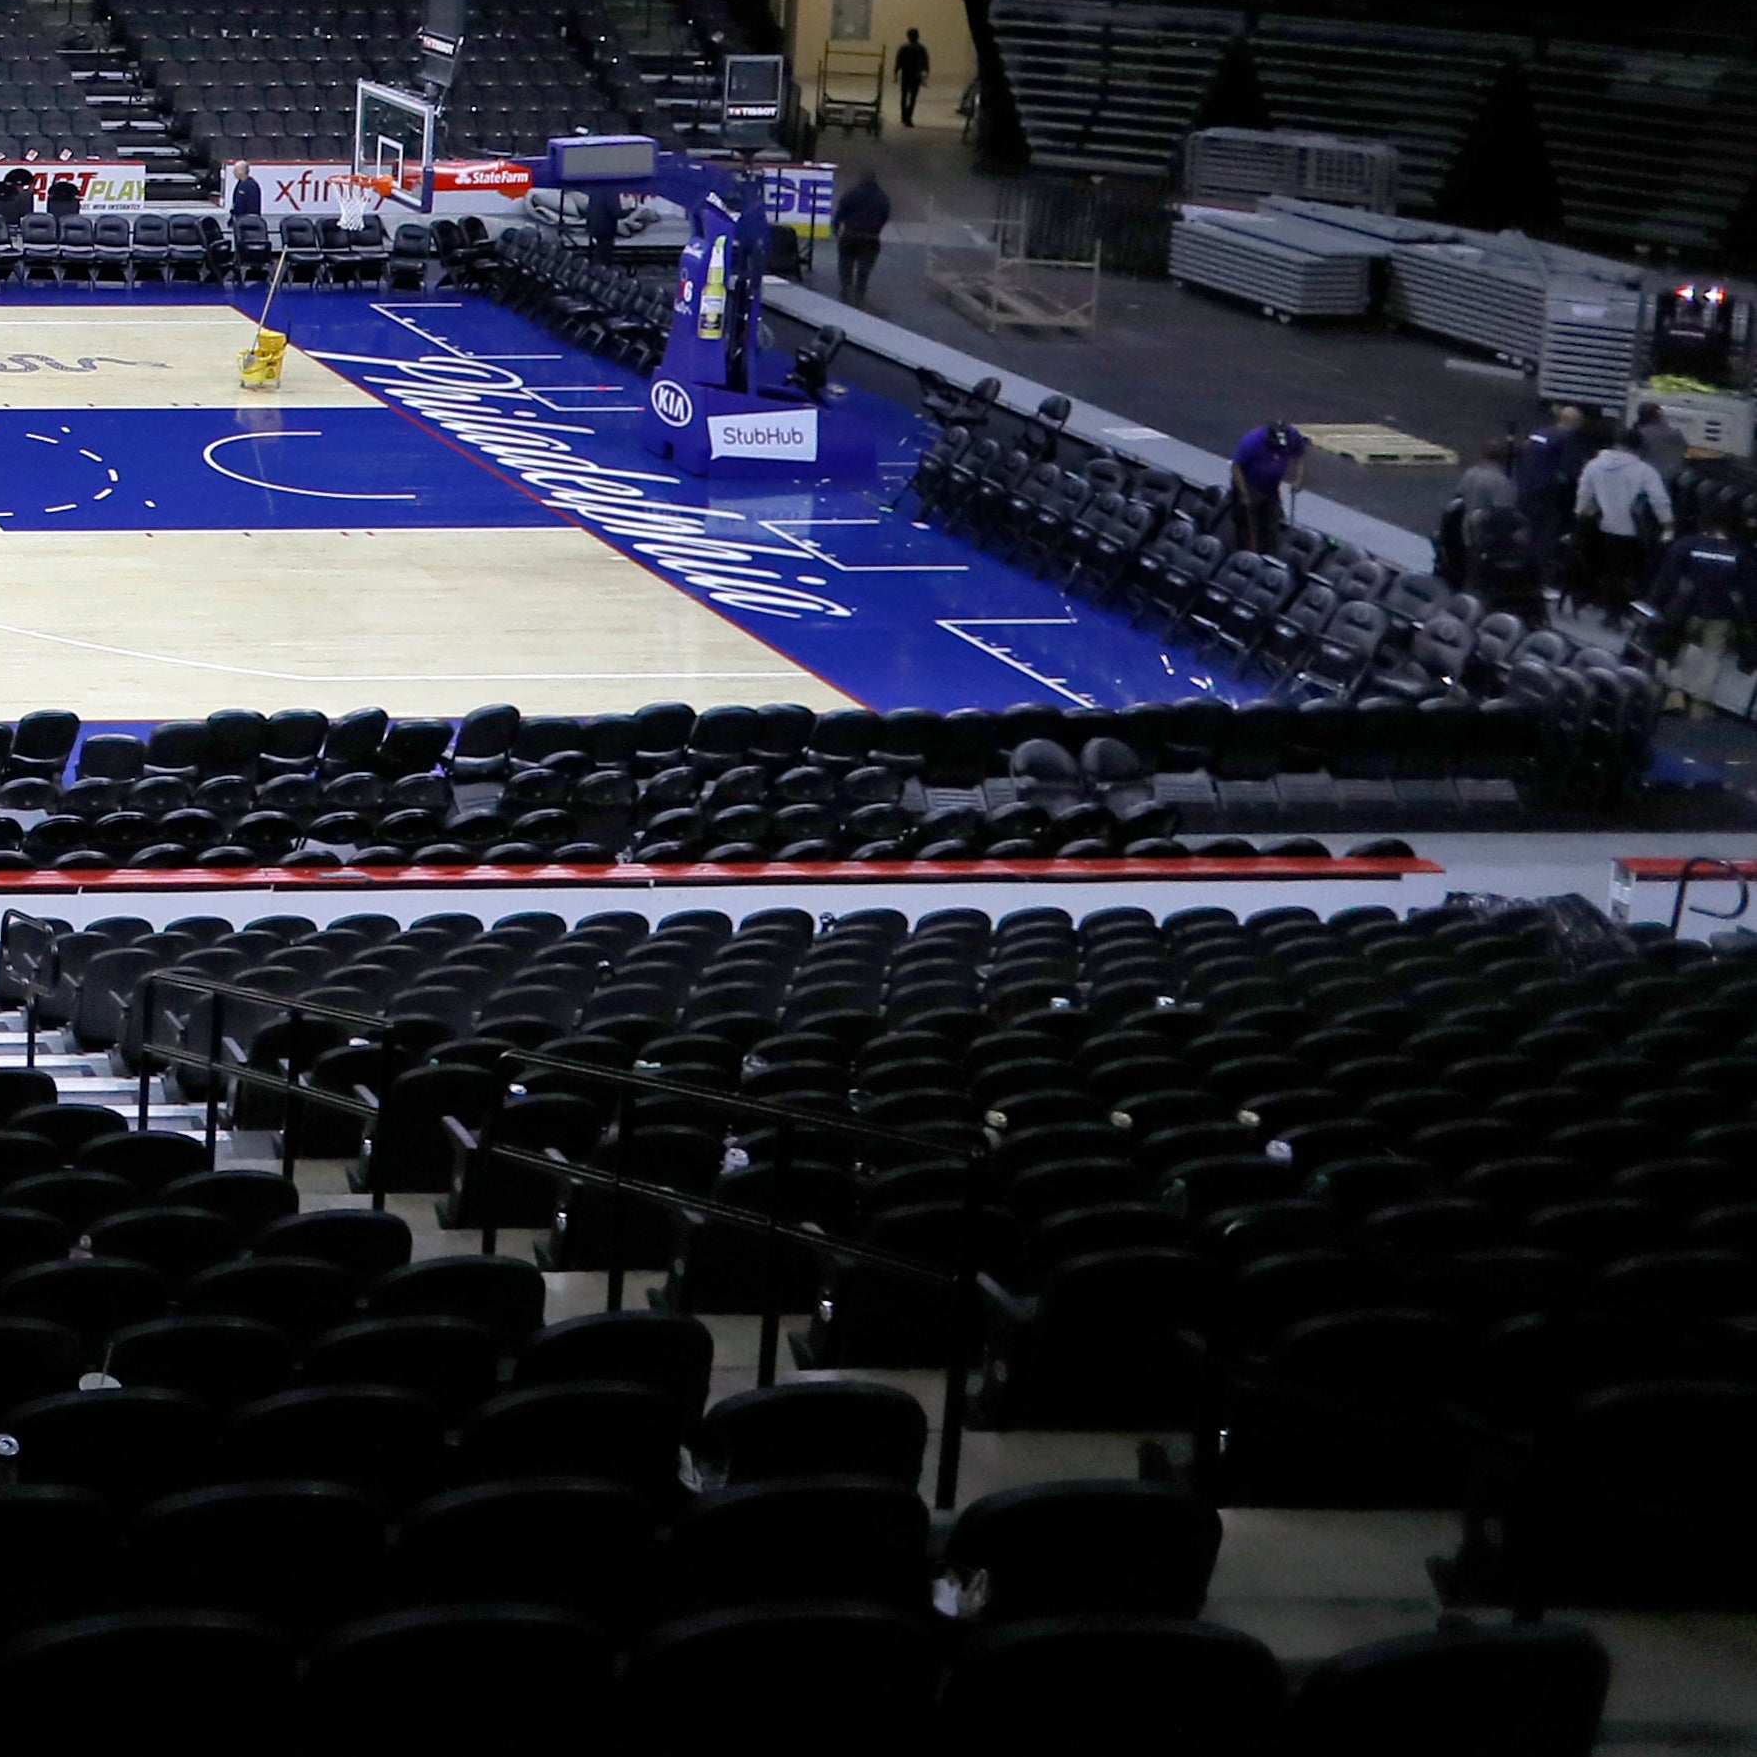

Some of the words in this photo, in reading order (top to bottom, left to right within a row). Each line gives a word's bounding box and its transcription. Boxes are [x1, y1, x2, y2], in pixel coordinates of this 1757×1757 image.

[656, 384, 687, 422] KIA
[723, 427, 803, 445] StubHub
[303, 349, 852, 619] Philadelphia
